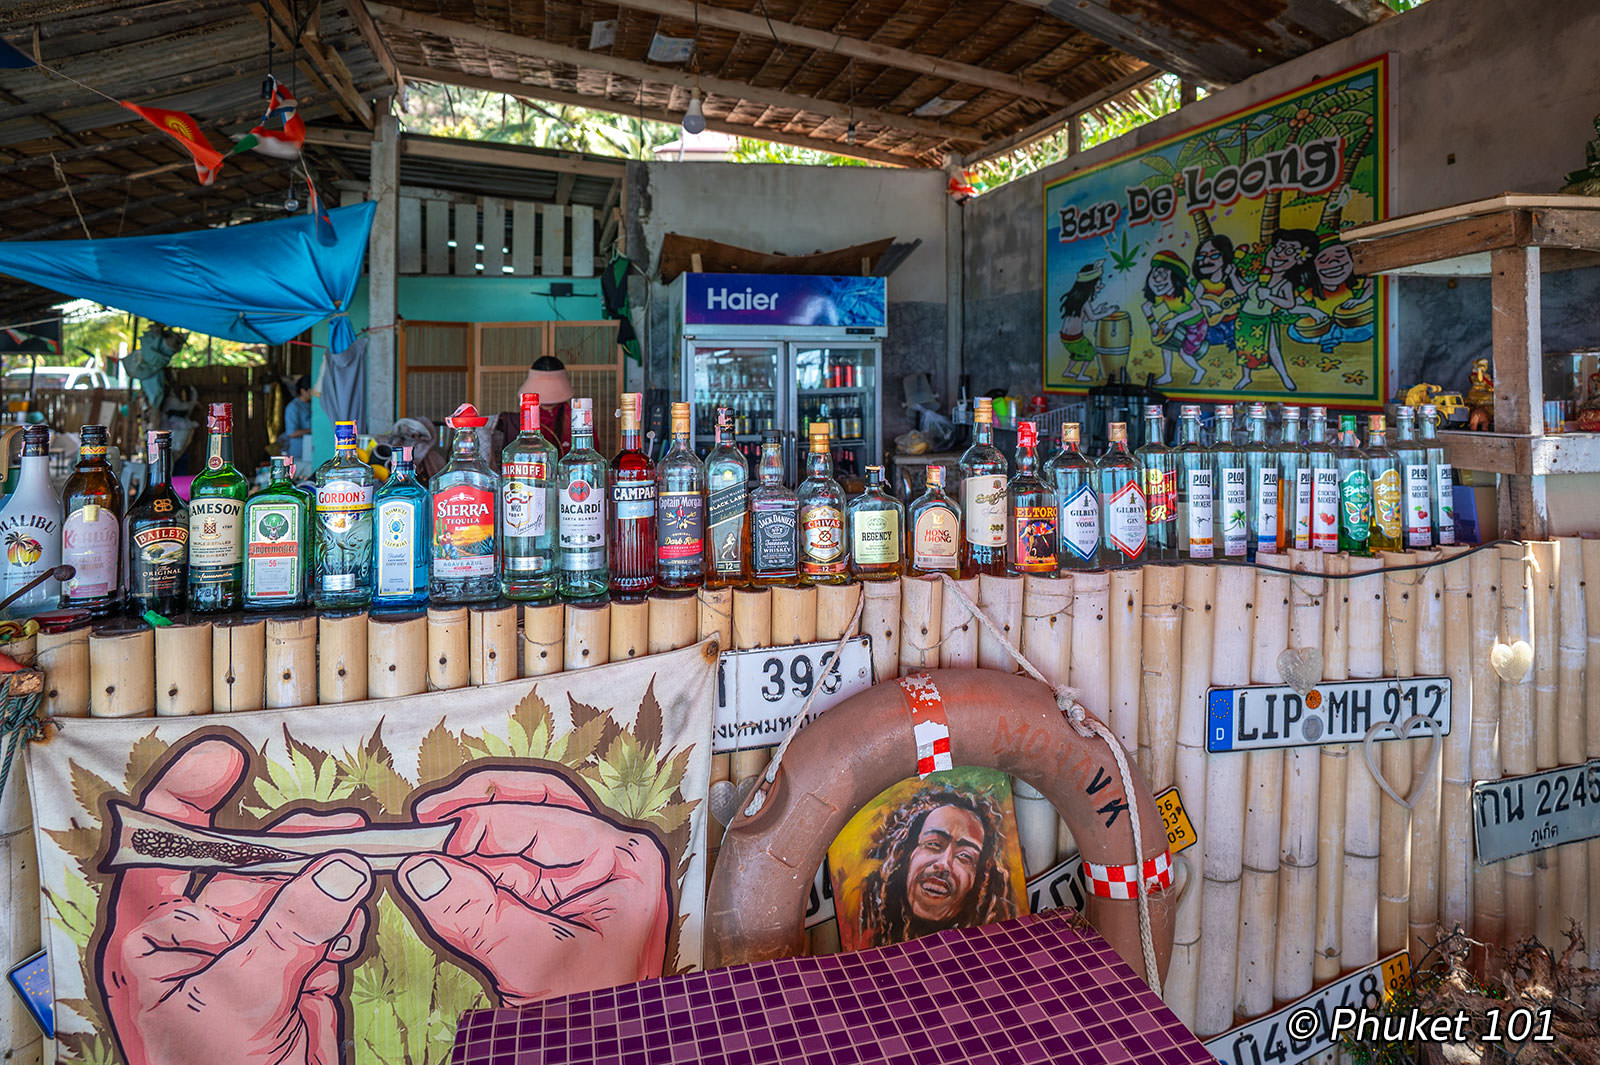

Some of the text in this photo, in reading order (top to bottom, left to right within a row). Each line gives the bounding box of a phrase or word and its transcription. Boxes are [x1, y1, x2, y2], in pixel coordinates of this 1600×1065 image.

[1060, 139, 1345, 242] Bar De Loong
[707, 287, 779, 311] Haier
[318, 490, 366, 504] GORDON'S
[437, 499, 490, 518] SIERRA
[808, 519, 840, 528] CHIVAS
[139, 528, 187, 544] BAILEYS
[861, 531, 892, 541] REGENCY
[924, 535, 952, 543] THONG
[925, 528, 950, 537] HONG
[142, 568, 181, 577] ORIGINAL
[725, 562, 733, 570] 12
[1238, 685, 1442, 741] LIP MH 912
[1216, 728, 1224, 740] D
[1167, 826, 1185, 843] 05
